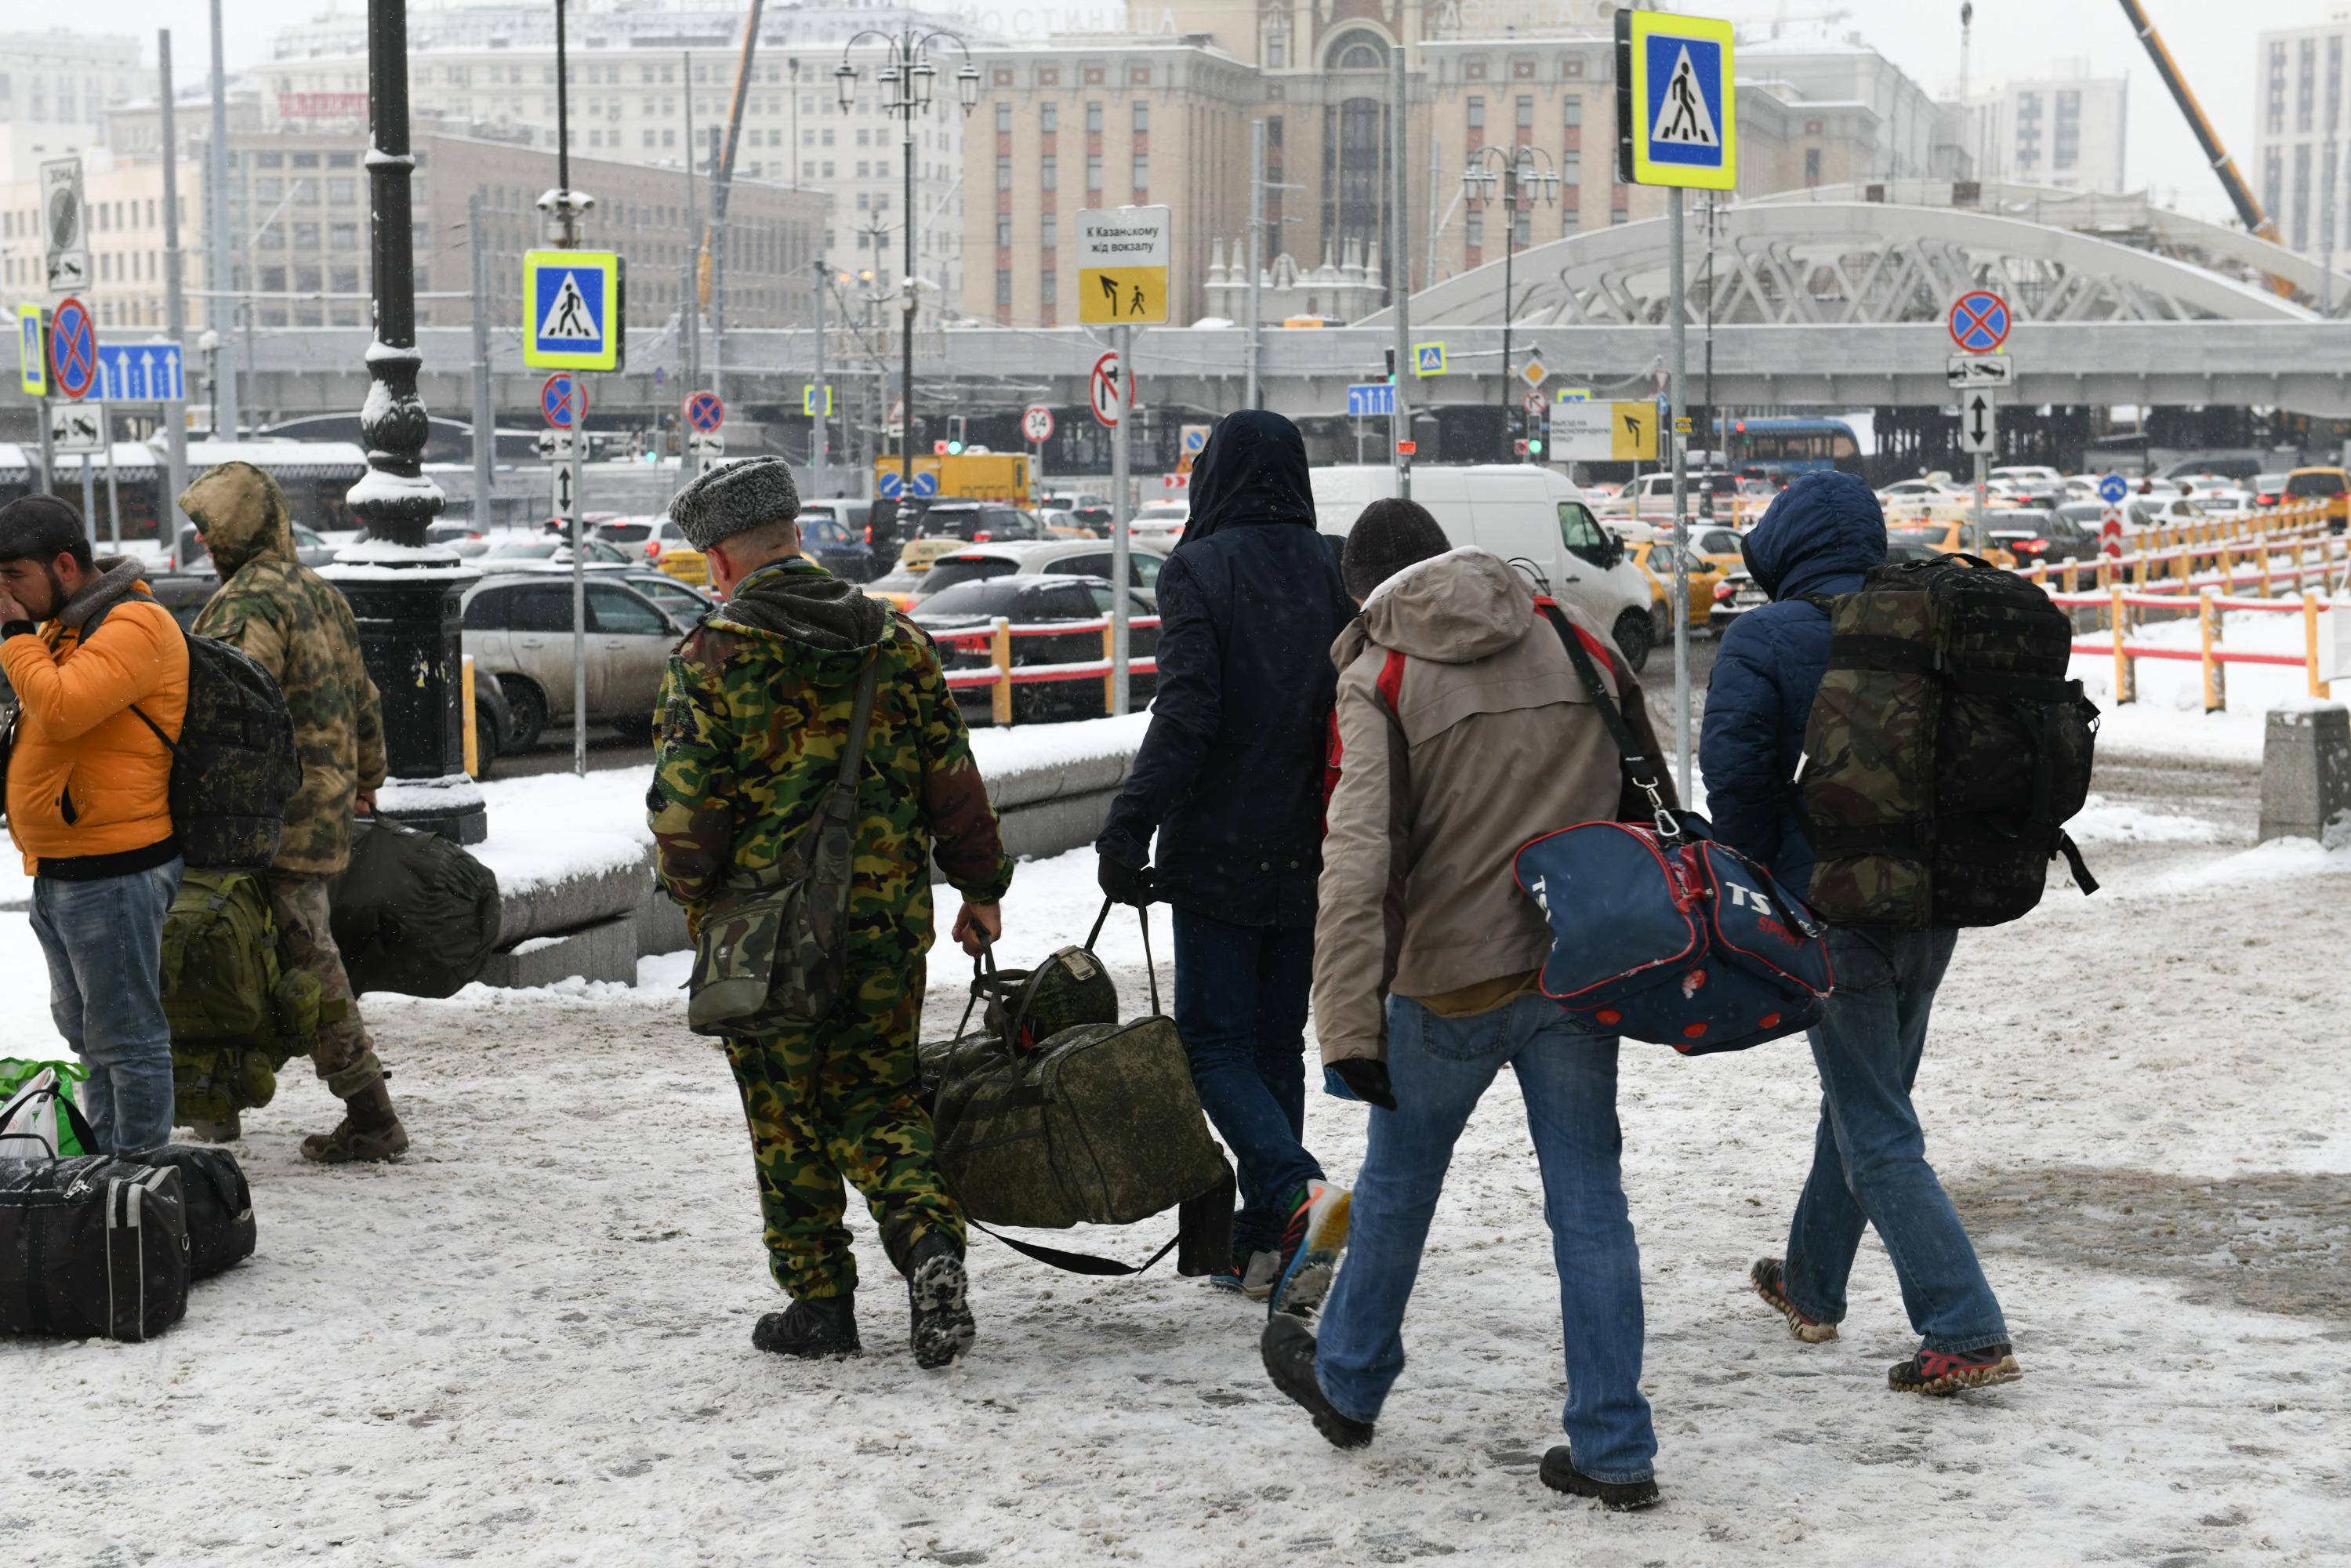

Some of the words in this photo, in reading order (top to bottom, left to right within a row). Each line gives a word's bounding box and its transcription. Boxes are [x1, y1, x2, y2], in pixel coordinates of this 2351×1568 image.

[969, 6, 1177, 38] ОСТИНИЦА
[1087, 227, 1094, 238] К
[1096, 226, 1159, 238] Казанскому
[1091, 241, 1109, 254] ж/д
[1111, 242, 1154, 254] вокзалу
